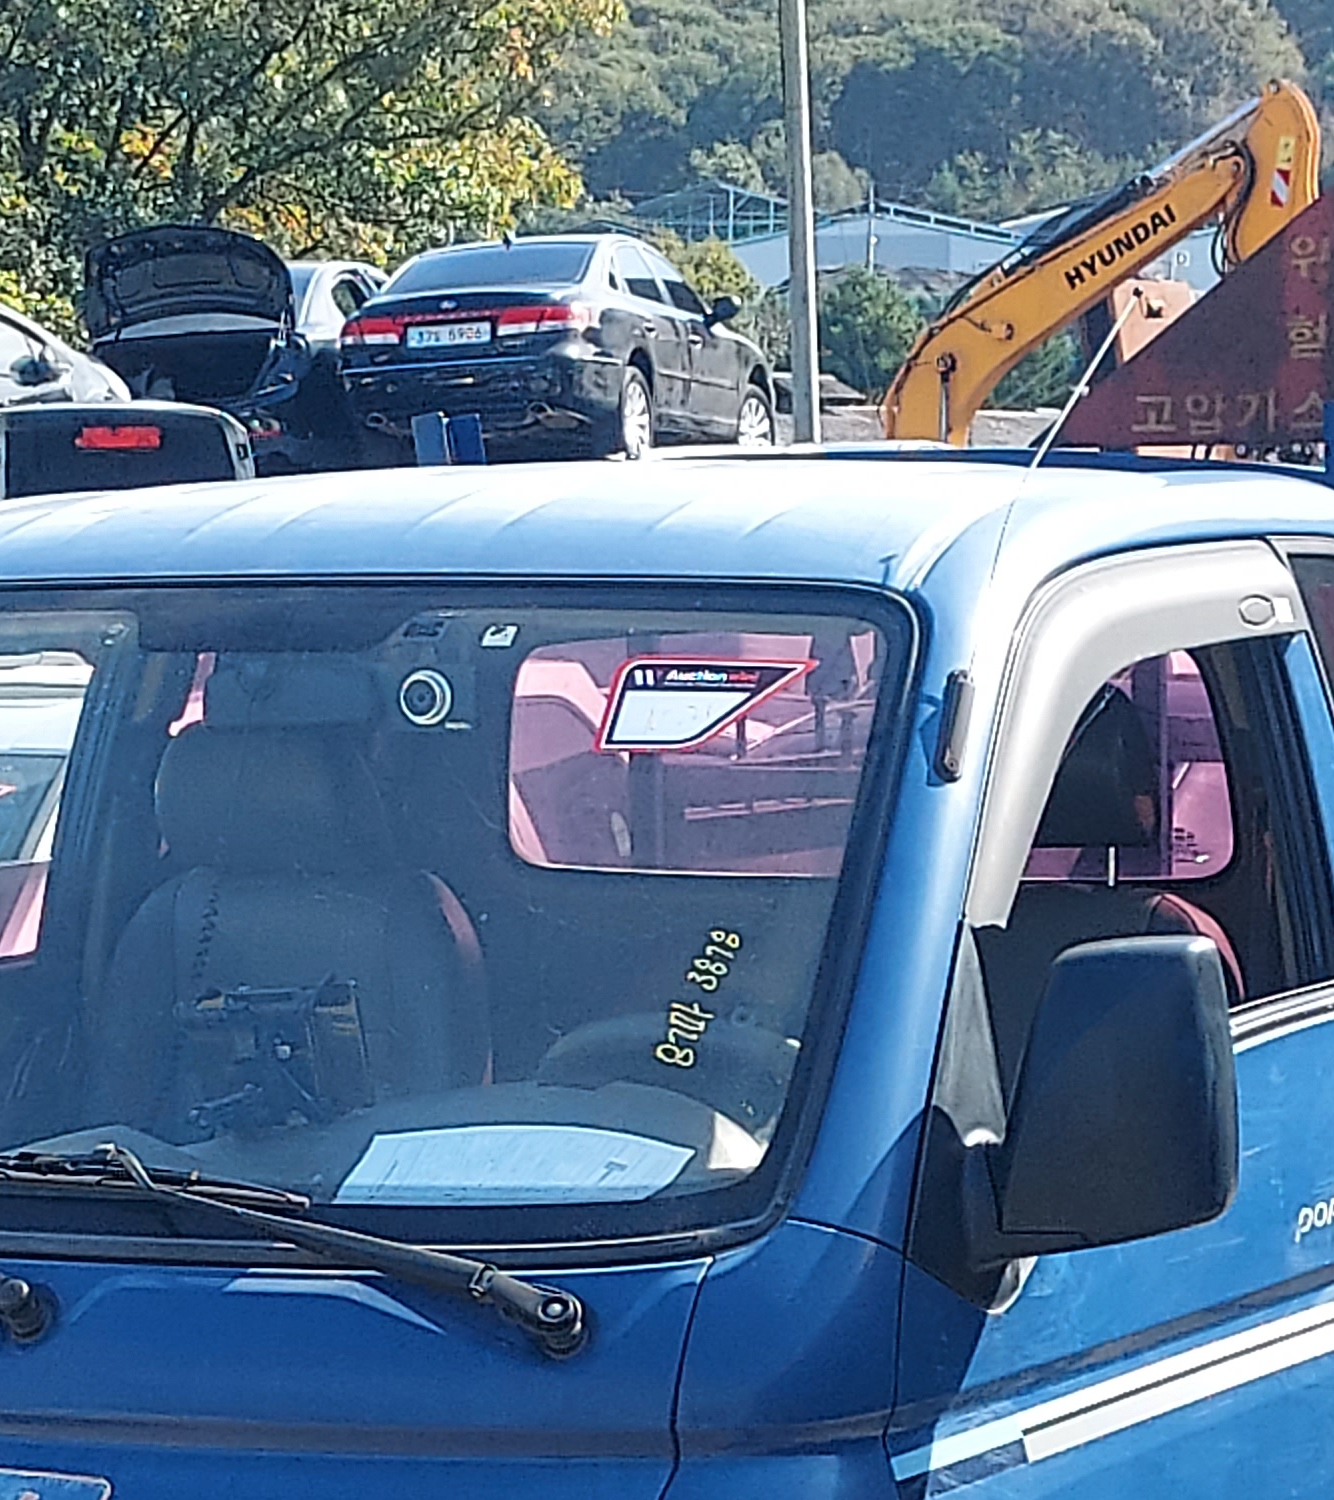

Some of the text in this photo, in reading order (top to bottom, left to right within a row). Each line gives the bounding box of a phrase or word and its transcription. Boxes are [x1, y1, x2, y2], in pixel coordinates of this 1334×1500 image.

[1064, 203, 1177, 290] HYUNDAI
[1286, 235, 1330, 359] 위험
[1131, 388, 1323, 436] 고압가스
[655, 930, 740, 1067] 87마 3878
